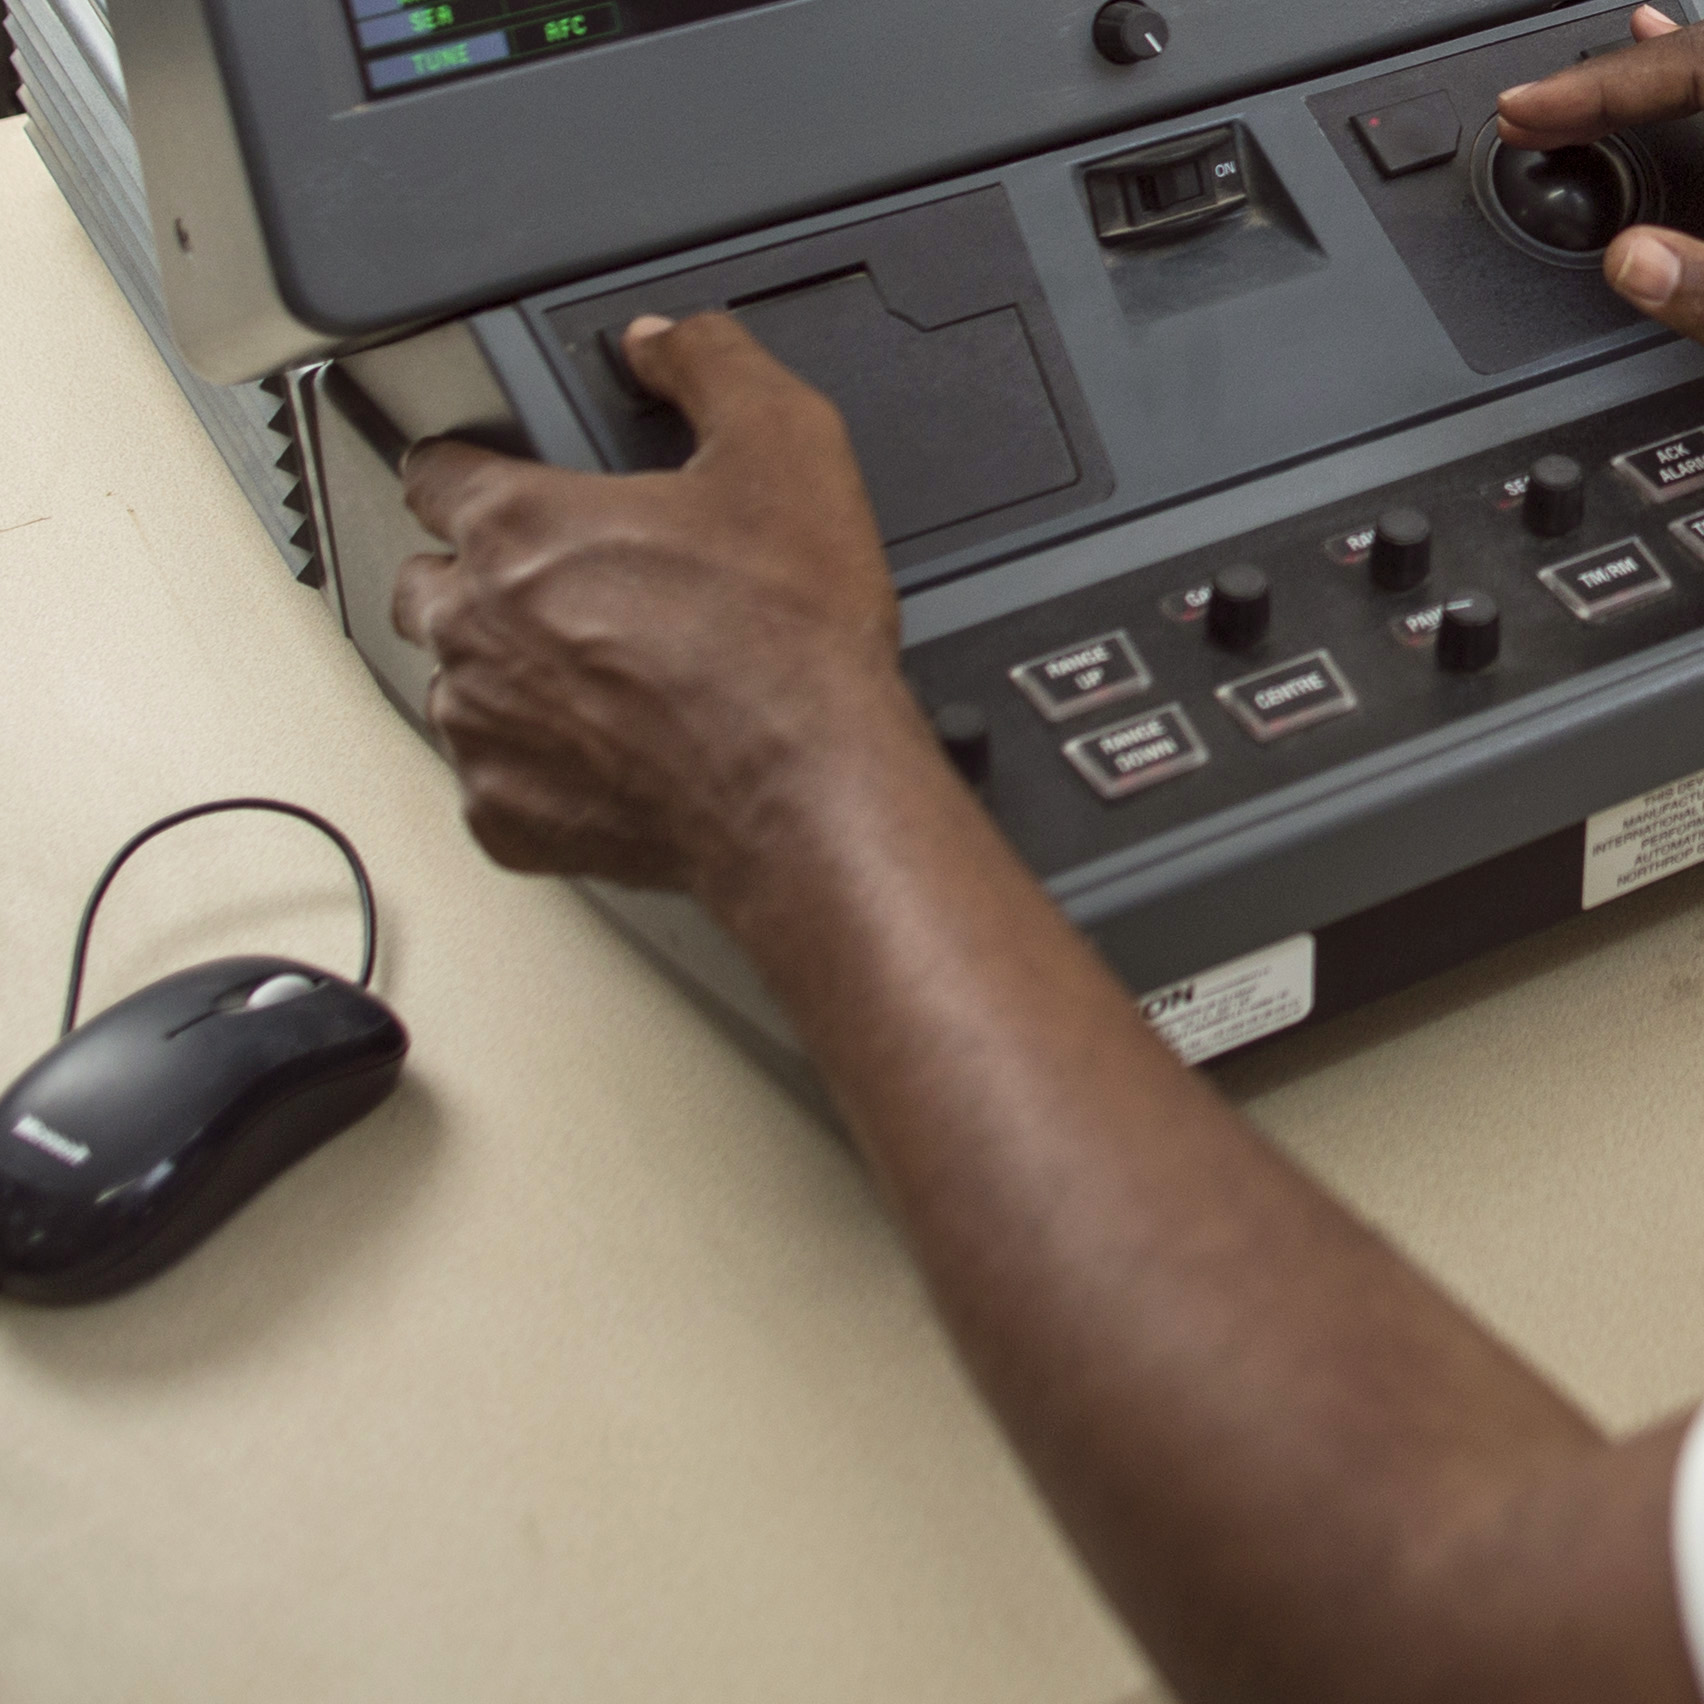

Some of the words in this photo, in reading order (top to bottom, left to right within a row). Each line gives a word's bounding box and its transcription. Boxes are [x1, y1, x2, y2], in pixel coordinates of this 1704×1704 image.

[1215, 162, 1236, 177] ON
[1656, 443, 1689, 463] ACK
[1578, 557, 1640, 589] TM/RM
[1046, 646, 1109, 679] RANGE
[1254, 672, 1325, 710] CENTRE
[1100, 721, 1165, 756] RANGE
